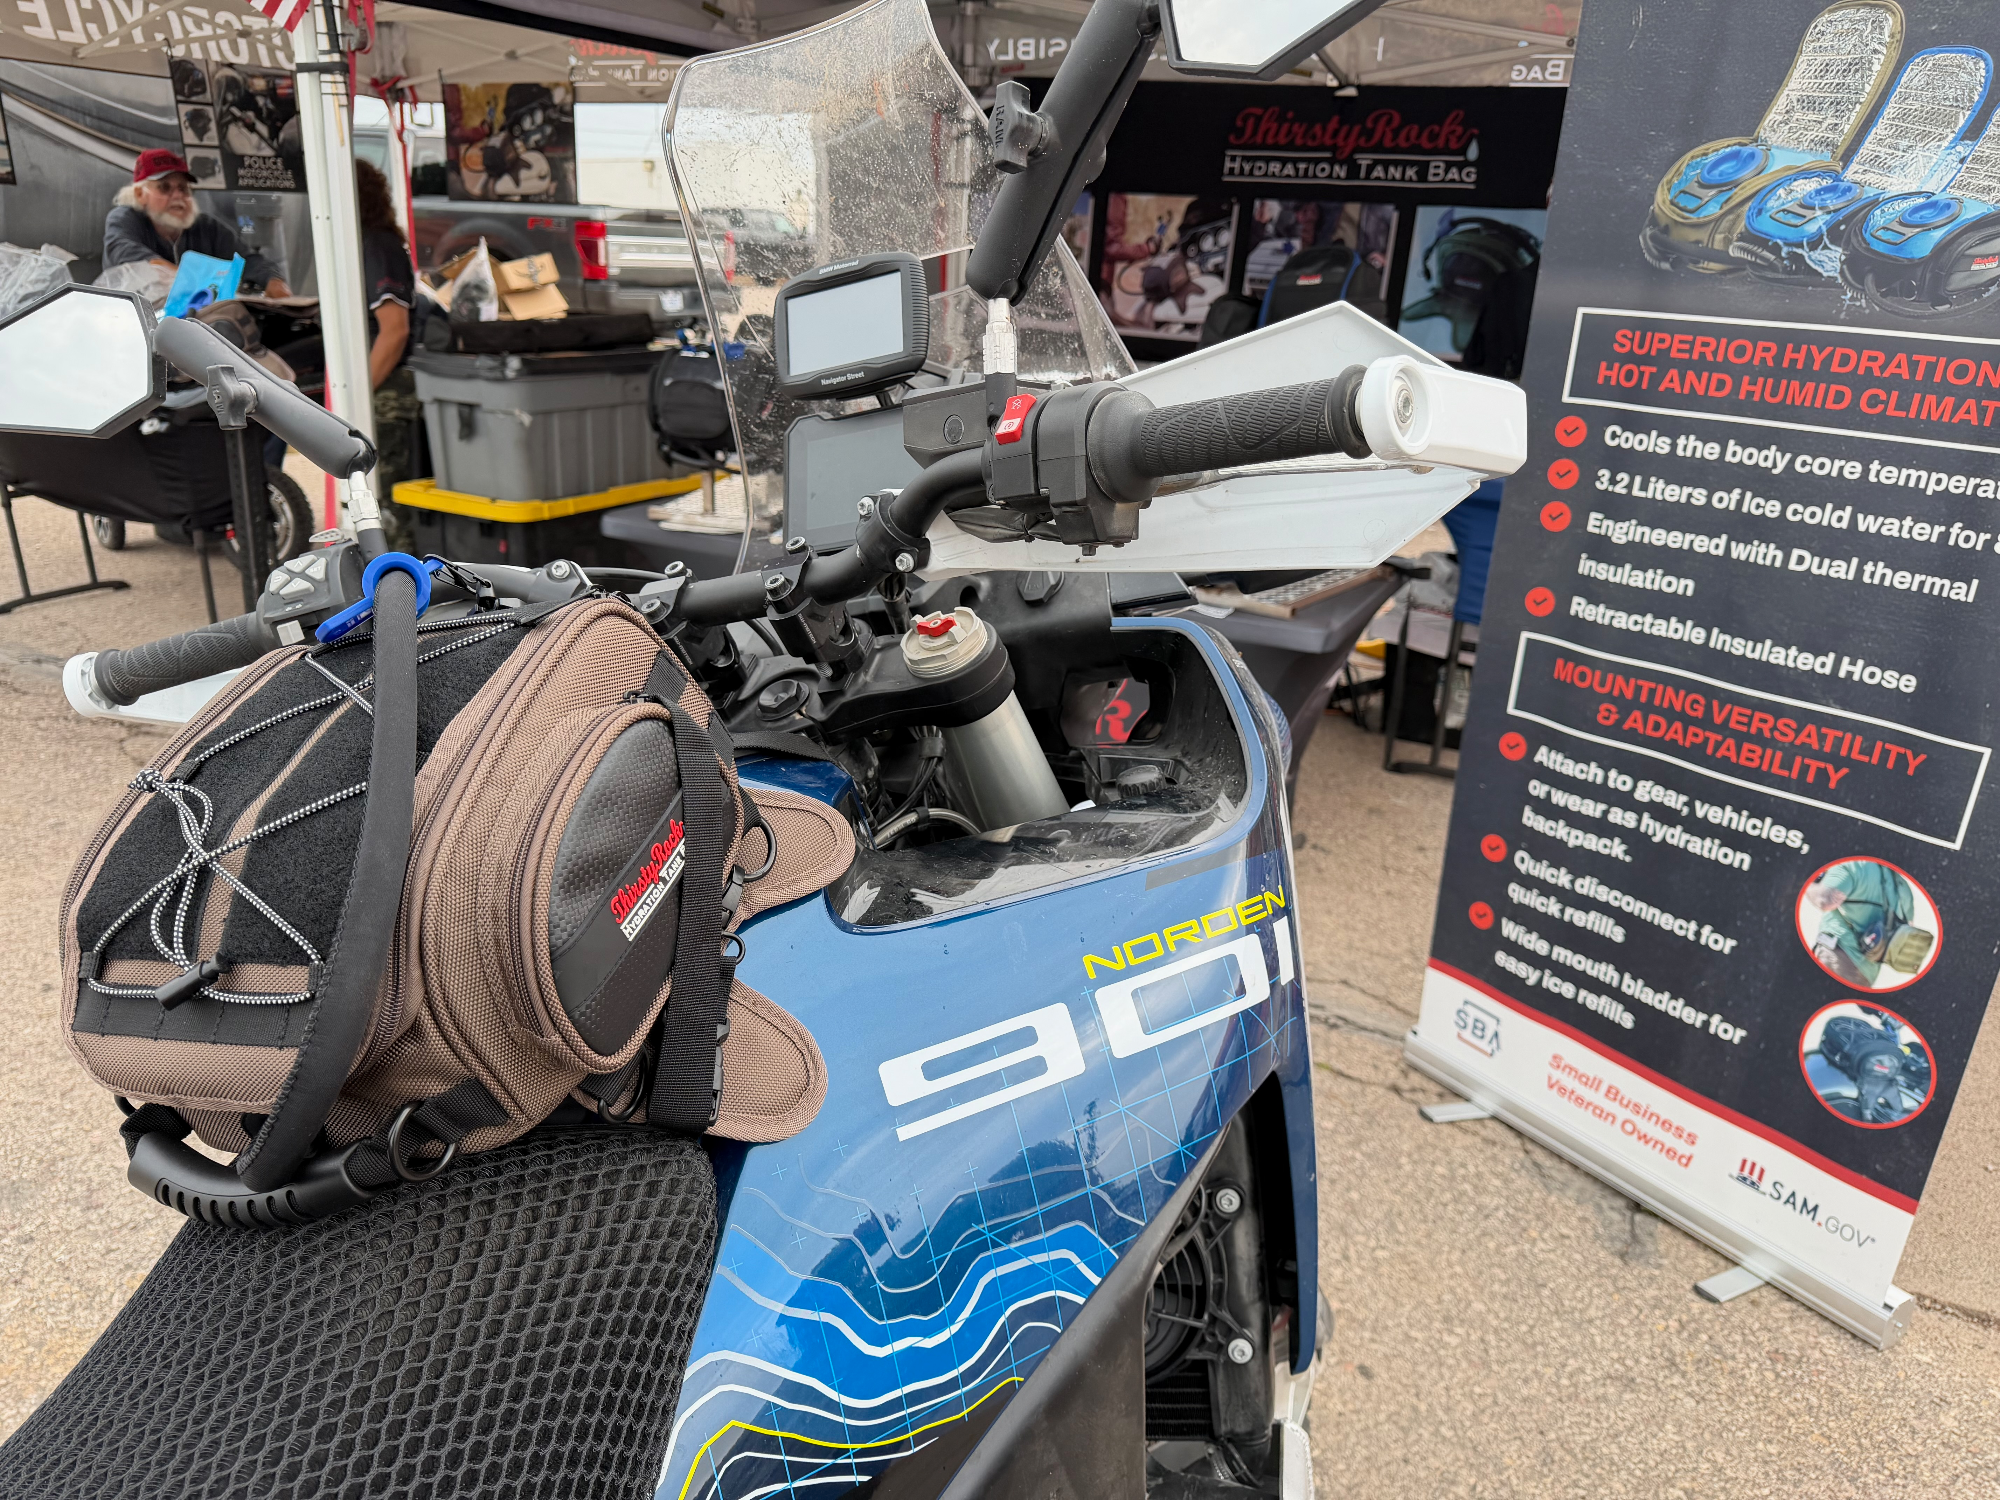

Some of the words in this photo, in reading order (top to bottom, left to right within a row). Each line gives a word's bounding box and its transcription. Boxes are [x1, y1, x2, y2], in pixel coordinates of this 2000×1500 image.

[243, 155, 285, 171] POLICE
[1223, 155, 1348, 180] HYDRATION
[1355, 159, 1418, 182] TANK
[1426, 160, 1478, 183] BAG
[1229, 107, 1479, 160] ThirstyRock
[820, 375, 847, 386] Navigator
[846, 371, 865, 381] Street
[1596, 360, 1658, 391] HOT
[1658, 368, 1733, 398] AND
[1737, 376, 1852, 411] HUMID
[1612, 328, 1777, 368] SUPERIOR
[1781, 343, 2000, 389] HYDRATION
[1603, 423, 1672, 455] Cools
[1675, 433, 1722, 462] the
[1724, 437, 1792, 475] body
[1793, 450, 1863, 482] core
[1594, 468, 1631, 495] 3.2
[1631, 474, 1708, 506] Liters
[1710, 485, 1741, 512] of
[1741, 490, 1782, 519] Ice
[1785, 493, 1851, 531] cold
[1855, 510, 1946, 544] water
[1947, 521, 1992, 552] for
[1577, 553, 1695, 597] insulation
[1586, 510, 1726, 557] Engineered
[1729, 536, 1783, 568] with
[1787, 545, 1859, 582] Dual
[1862, 556, 1979, 604] thermal
[1569, 595, 1706, 647] Retractable
[1708, 629, 1833, 677] Insulated
[1837, 655, 1919, 694] Hose
[1553, 658, 1705, 718] MOUNTING
[1710, 698, 1927, 777] VERSATILITY
[1596, 704, 1619, 727] &
[1622, 709, 1850, 790] ADAPTABILITY
[1521, 804, 1633, 864] backpack.
[1527, 778, 1549, 800] or
[1547, 783, 1608, 820] wear
[1608, 804, 1638, 830] as
[1640, 810, 1753, 872] hydration
[1533, 743, 1604, 785] Attach
[1606, 767, 1633, 792] to
[1634, 777, 1691, 816] gear,
[1693, 798, 1811, 855] vehicles,
[610, 818, 685, 924] ThirstyRock
[622, 881, 666, 939] HYDRATION
[664, 855, 683, 882] TANK
[1507, 882, 1564, 920] quick
[1563, 904, 1627, 944] refills
[1513, 849, 1574, 890] Quick
[1574, 875, 1699, 942] disconnect
[1699, 924, 1739, 955] for
[1083, 885, 1288, 980] NORDEN
[1494, 950, 1542, 987] easy
[1541, 968, 1577, 1000] ice
[1577, 987, 1636, 1030] refills
[1500, 916, 1551, 957] Wide
[1551, 944, 1621, 988] mouth
[1621, 971, 1708, 1029] bladder
[1708, 1013, 1748, 1045] for
[878, 915, 1295, 1142] 901
[1454, 1007, 1501, 1051] SBA
[1546, 1073, 1618, 1126] Veteran
[1620, 1117, 1695, 1169] Owned
[1548, 1052, 1604, 1094] Small
[1603, 1083, 1699, 1147] Business
